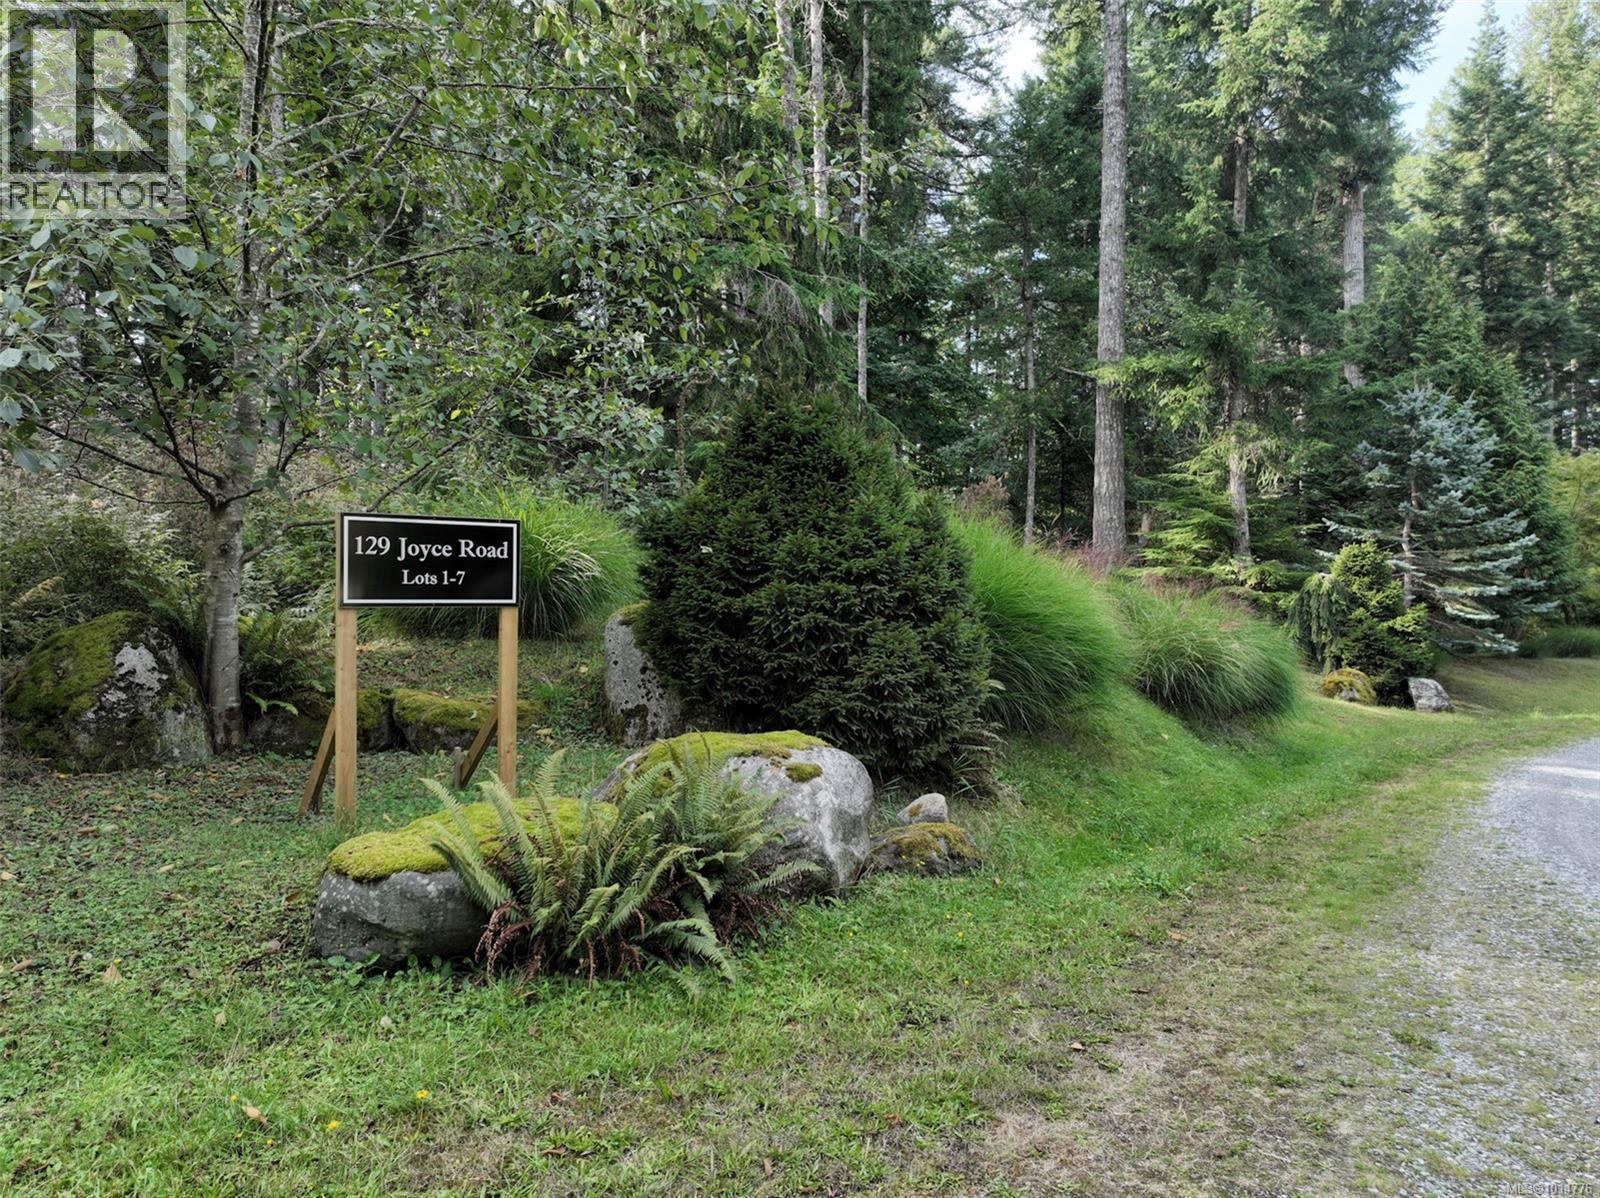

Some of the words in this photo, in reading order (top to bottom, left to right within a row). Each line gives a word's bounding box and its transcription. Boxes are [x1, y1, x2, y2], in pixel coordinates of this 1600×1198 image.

[354, 535, 391, 555] 129
[397, 536, 453, 562] Joyce
[458, 539, 509, 559] Road
[401, 569, 437, 585] Lots
[442, 570, 466, 585] 1-7
